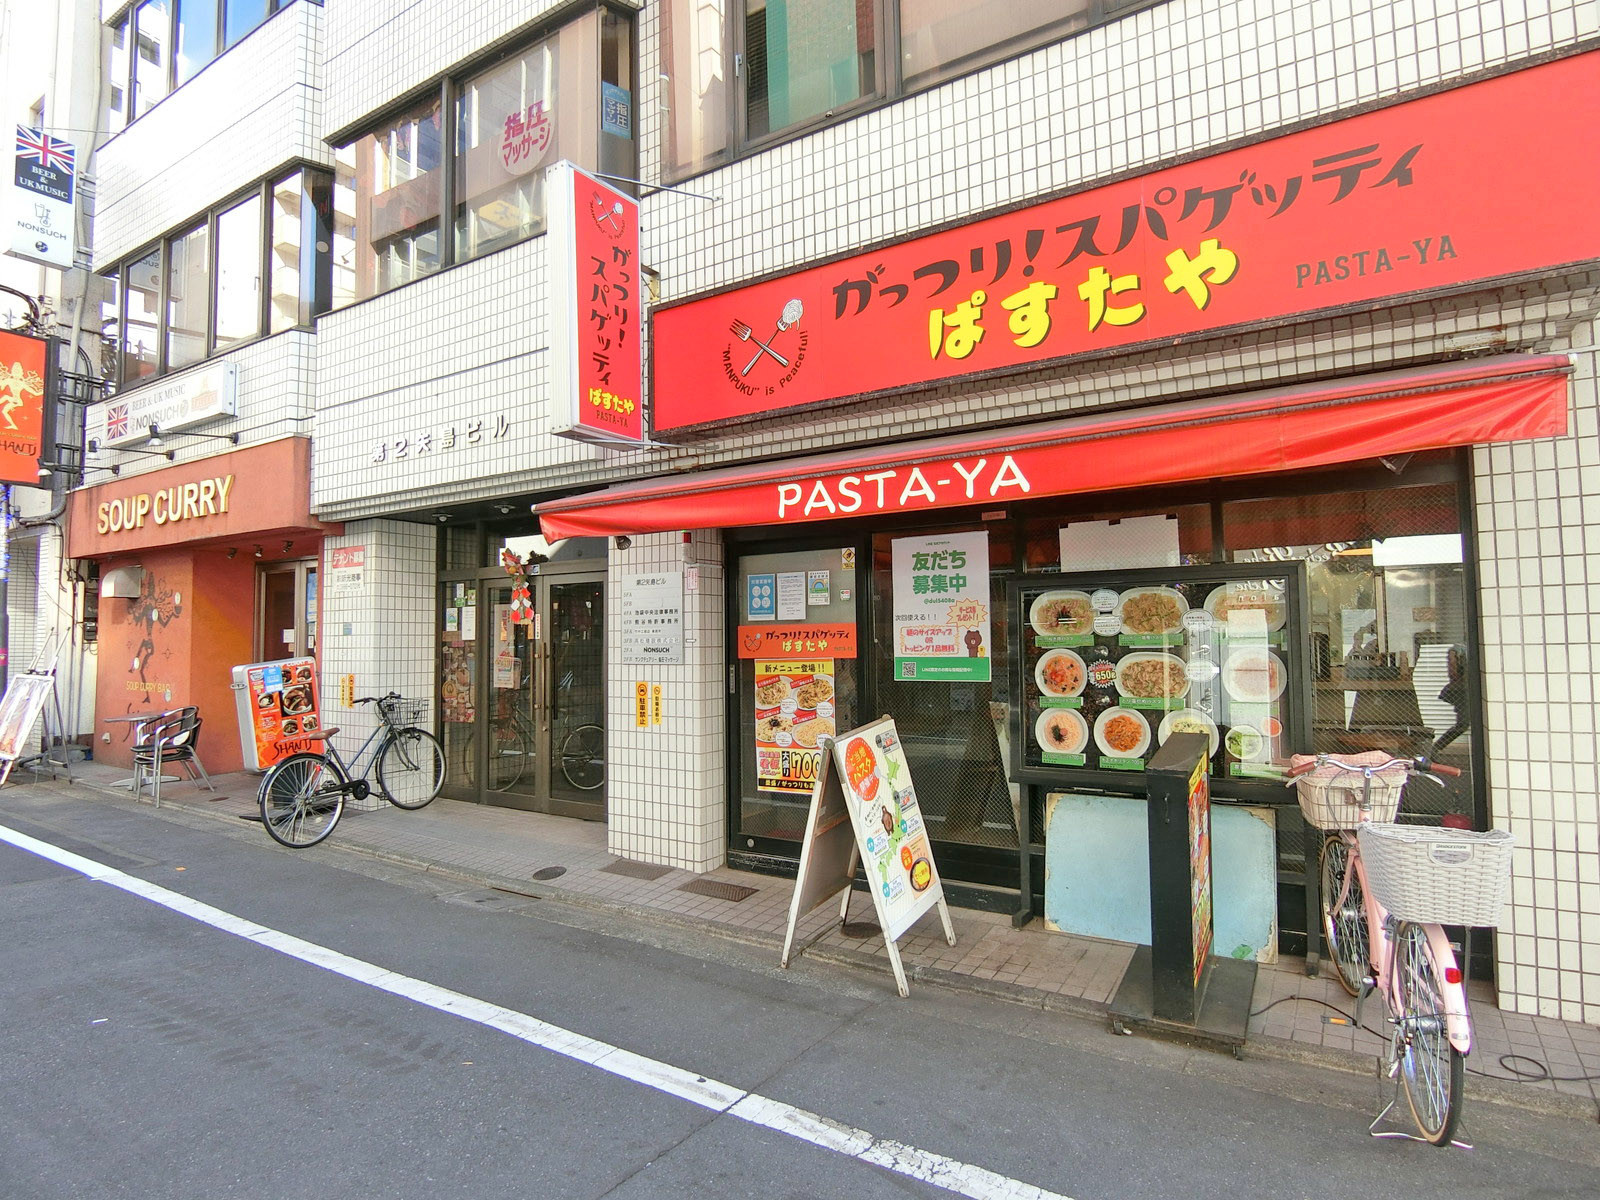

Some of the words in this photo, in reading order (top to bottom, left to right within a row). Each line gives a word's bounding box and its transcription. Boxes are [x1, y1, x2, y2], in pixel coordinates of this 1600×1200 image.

[504, 100, 548, 141] 指圧
[616, 102, 628, 129] 指圧
[502, 125, 551, 168] マッサージ
[31, 165, 57, 180] BEER
[40, 176, 48, 184] &
[19, 176, 37, 188] UK
[36, 182, 69, 199] MUSIC
[17, 220, 67, 240] NONSUCH
[830, 143, 1424, 320] がっつり!スパゲッティ
[1295, 234, 1458, 289] PASTA-YA
[612, 246, 632, 348] がっつり!
[929, 238, 1239, 362] ぱすたや
[590, 255, 612, 386] スパゲッティ
[132, 398, 148, 412] BEER
[164, 384, 187, 399] MUSIC
[588, 387, 634, 416] ぱすたや
[765, 386, 775, 396] is
[135, 404, 180, 431] NONSUCH
[596, 410, 629, 428] PASTA-YA
[0, 440, 37, 456] HANTI
[777, 455, 1031, 519] PASTA-YA
[97, 494, 150, 535] SOUP
[153, 474, 235, 526] CURRY
[912, 549, 967, 571] 友だち
[912, 573, 968, 595] 募集中
[765, 630, 850, 641] がっつり!スパゲッティ
[782, 639, 828, 653] ぱすたや
[924, 636, 934, 644] OR
[765, 663, 825, 674] 新メニュー登場!!
[126, 680, 139, 691] SOUP
[782, 751, 790, 777] 大盛り
[853, 757, 872, 783] パスタ
